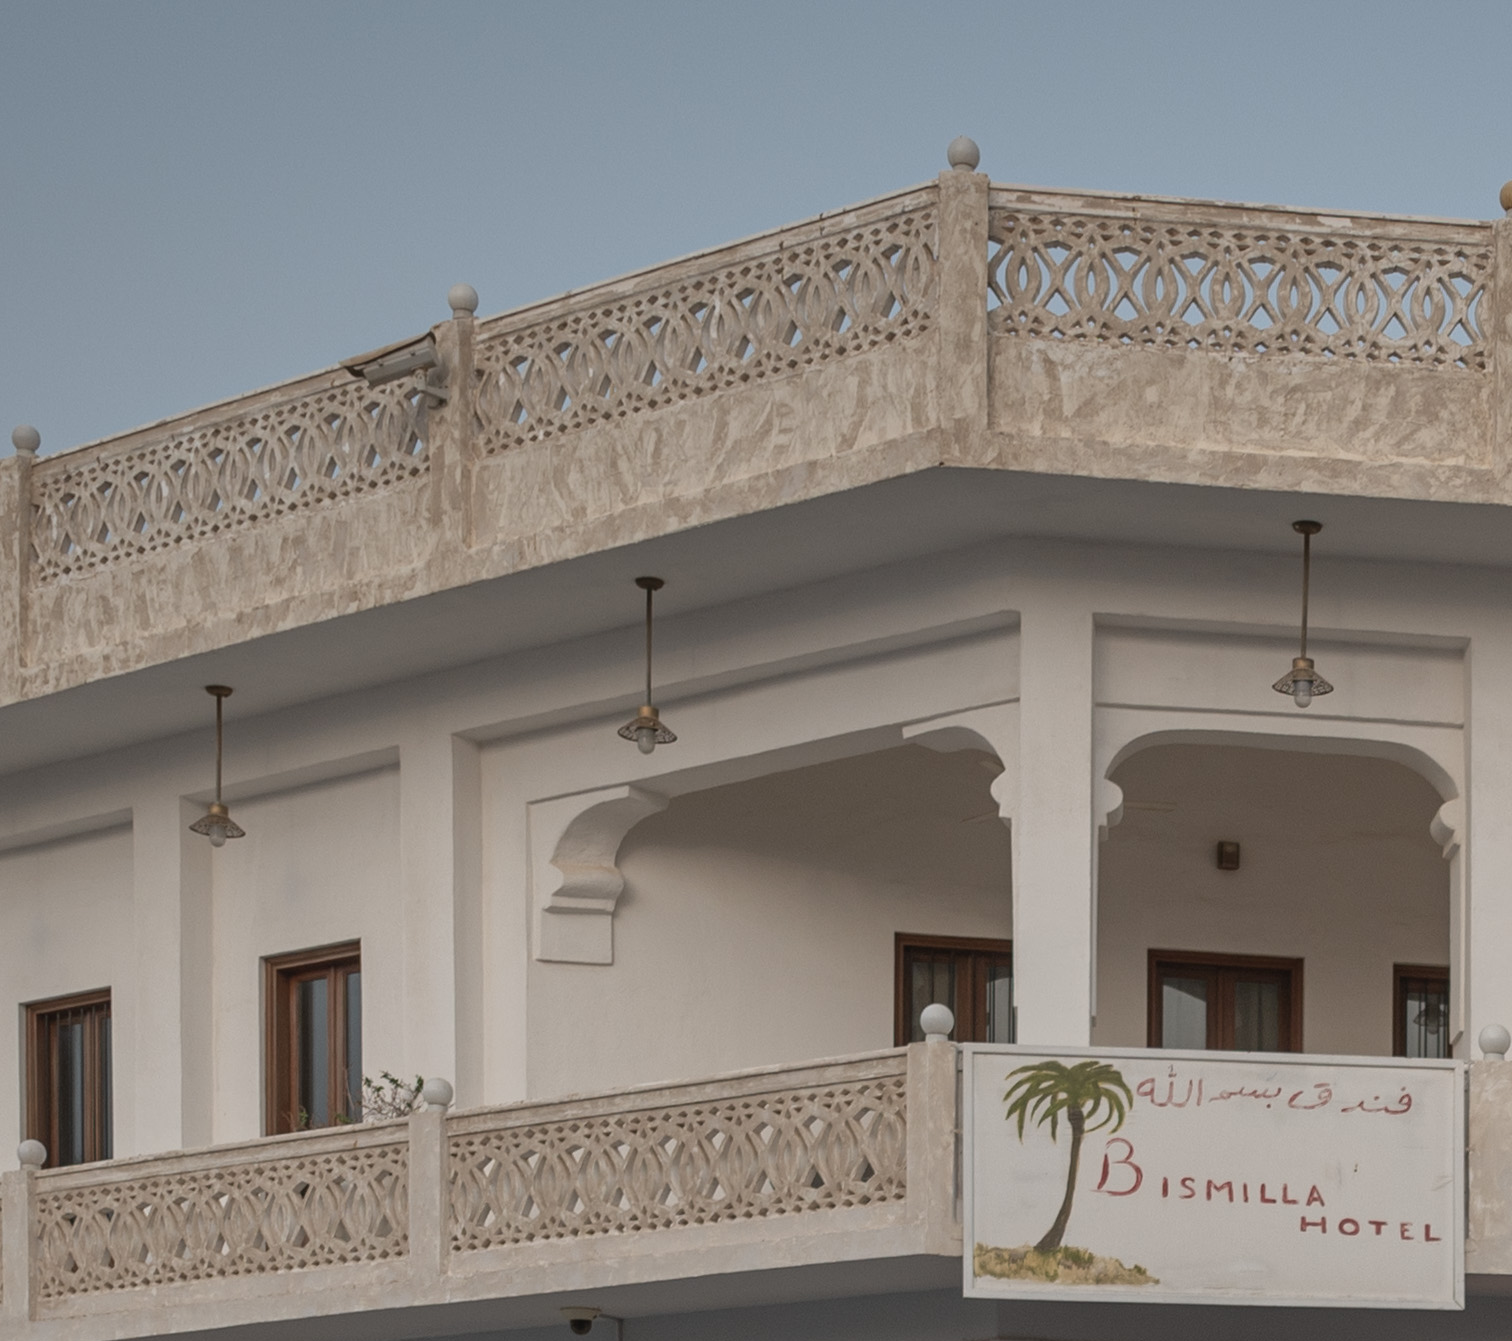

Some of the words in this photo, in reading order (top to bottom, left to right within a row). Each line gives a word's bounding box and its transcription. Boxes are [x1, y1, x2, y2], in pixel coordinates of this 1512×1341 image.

[1137, 1064, 1204, 1108] الله
[1288, 1083, 1415, 1115] فندق
[1300, 1216, 1443, 1242] HOTEL
